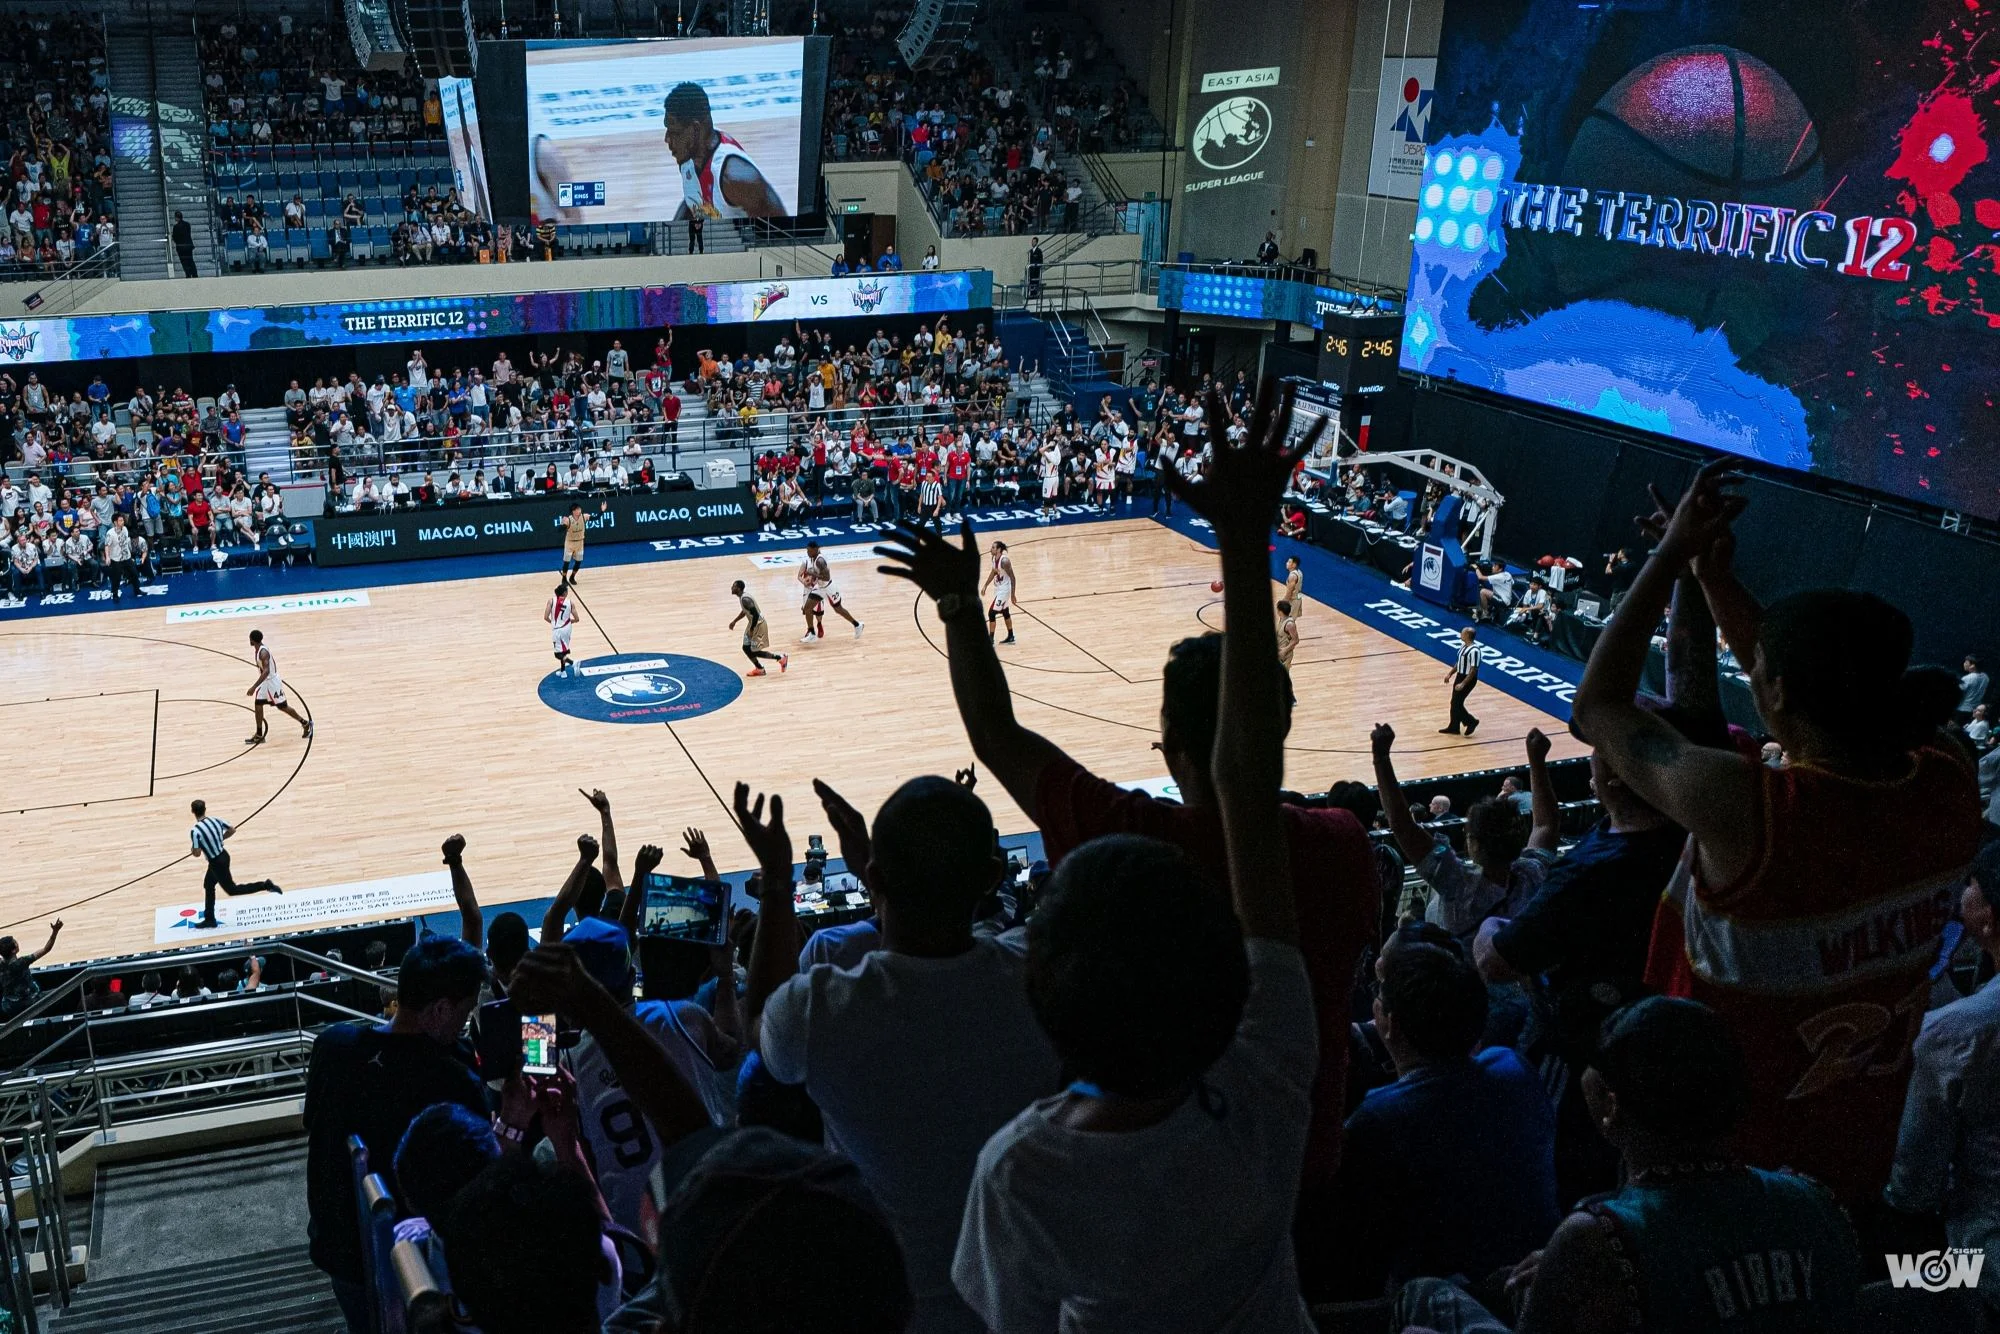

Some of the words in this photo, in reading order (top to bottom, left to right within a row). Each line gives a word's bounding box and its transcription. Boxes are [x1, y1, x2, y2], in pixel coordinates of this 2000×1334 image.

[1208, 76, 1241, 88] EAST
[1245, 72, 1275, 84] ASIA
[1184, 178, 1222, 193] SUPER
[1224, 170, 1264, 186] LEAGUE
[1501, 182, 1589, 237] THE
[1595, 190, 1837, 268] TERRIFIC
[1837, 216, 1918, 281] 12
[810, 295, 828, 306] VS
[345, 316, 376, 331] THE
[378, 312, 446, 329] TERRIFIC
[448, 311, 464, 325] 12
[1326, 336, 1348, 356] 2:46
[1361, 340, 1393, 358] 2:46
[635, 507, 692, 523] MACAO,
[697, 503, 744, 518] CHINA
[331, 529, 396, 550] 中國澳門
[418, 524, 479, 541] MACAO,
[484, 520, 534, 536] CHINA
[650, 534, 745, 551] EAST
[758, 523, 845, 542] ASIA
[281, 596, 358, 609] CHINA
[1364, 598, 1441, 630] THE
[588, 666, 625, 674] EAST
[629, 662, 663, 670] ASIA
[608, 708, 650, 719] SUPER
[653, 702, 702, 714] LEAGUE
[236, 912, 277, 922] Instituto
[296, 904, 343, 914] Desporto
[360, 896, 405, 905] Governo
[236, 919, 272, 927] Sports
[276, 913, 313, 922] Bureau
[330, 906, 364, 914] Macao
[600, 1100, 653, 1169] 9
[1704, 1249, 1814, 1320] BIBBY
